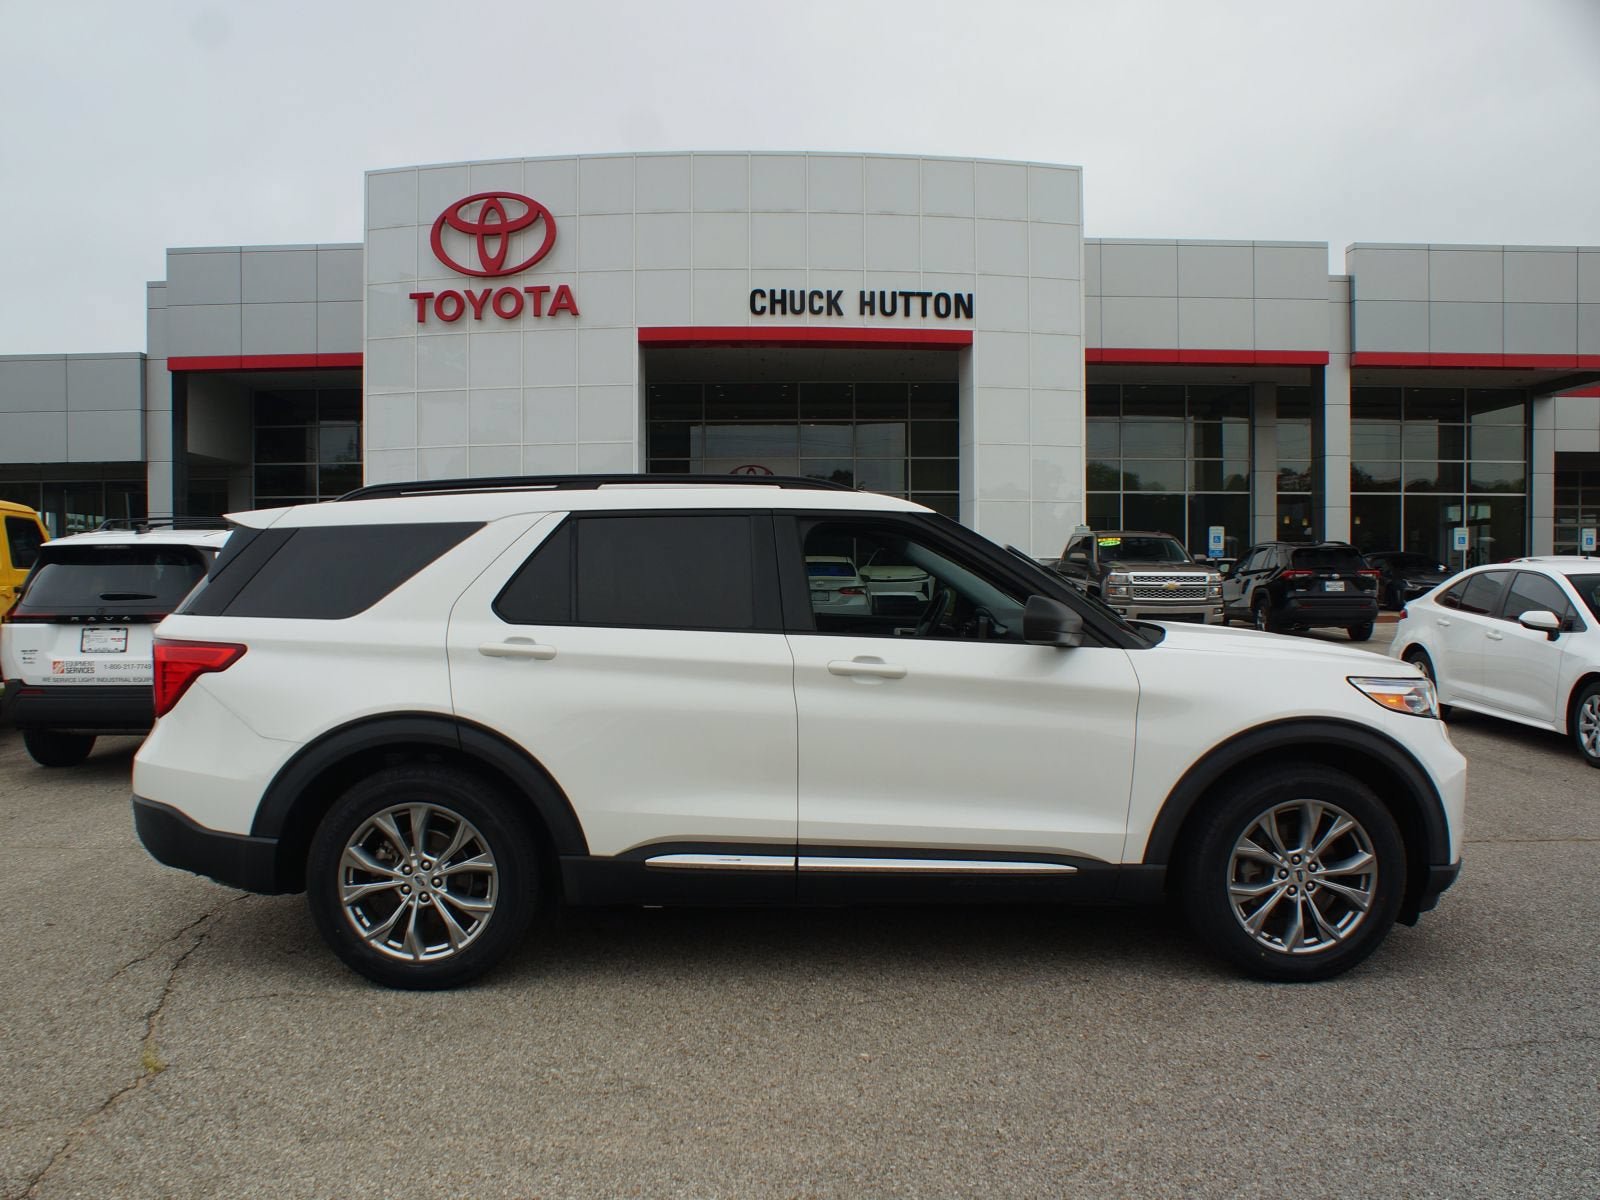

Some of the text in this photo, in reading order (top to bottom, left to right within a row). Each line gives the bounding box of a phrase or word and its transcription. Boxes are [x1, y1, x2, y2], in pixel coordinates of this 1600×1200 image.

[409, 284, 579, 323] TOYOTA
[750, 288, 974, 319] CHUCK HUTTON
